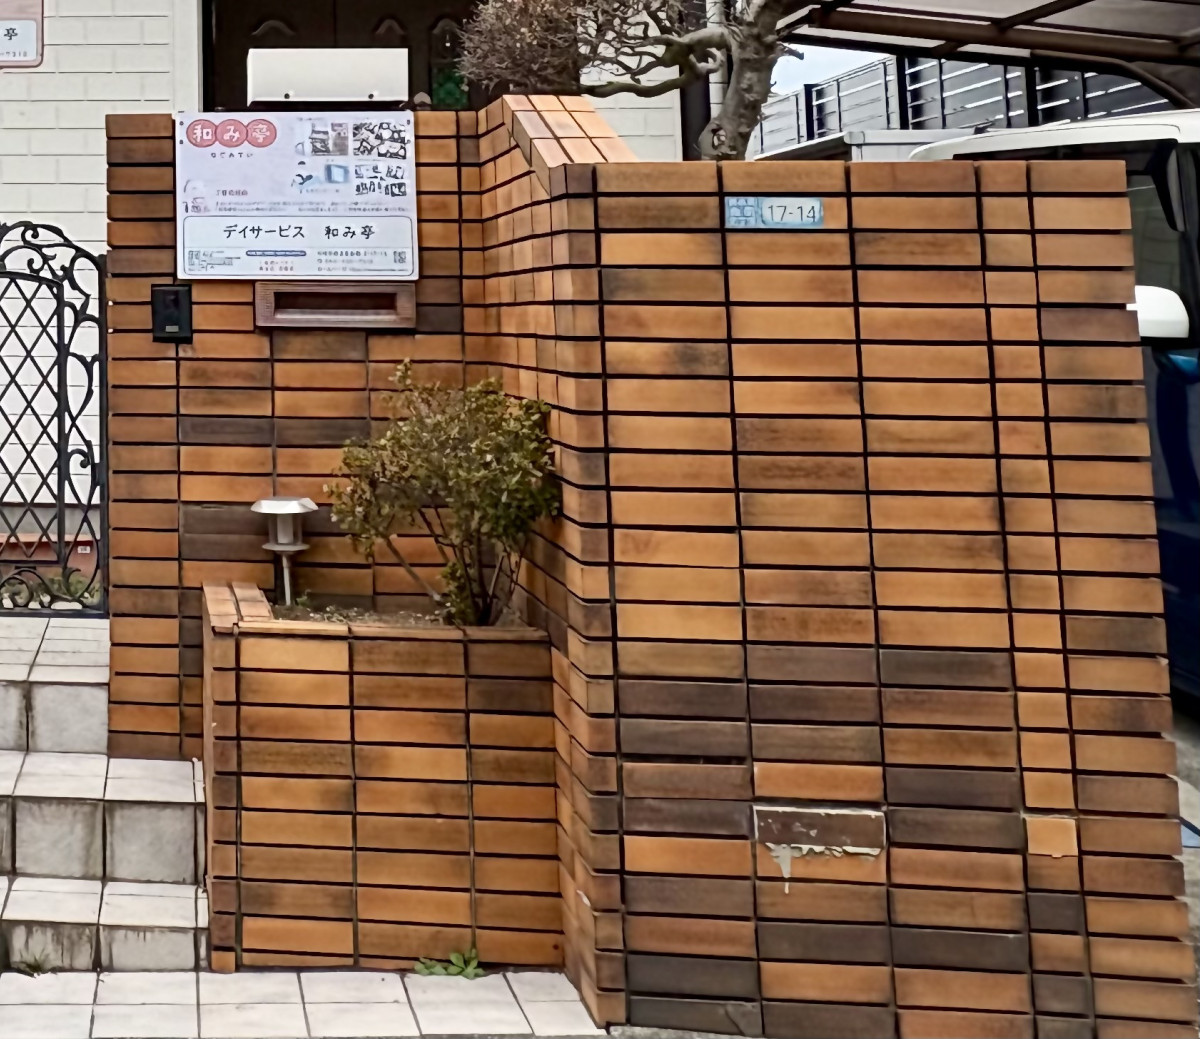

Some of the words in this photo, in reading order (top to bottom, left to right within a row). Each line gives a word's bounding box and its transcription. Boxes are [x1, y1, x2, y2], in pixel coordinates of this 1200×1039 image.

[192, 123, 270, 143] 和み亭
[767, 205, 816, 223] 17-14
[223, 224, 306, 239] デイサービス
[324, 225, 376, 240] 和み亭
